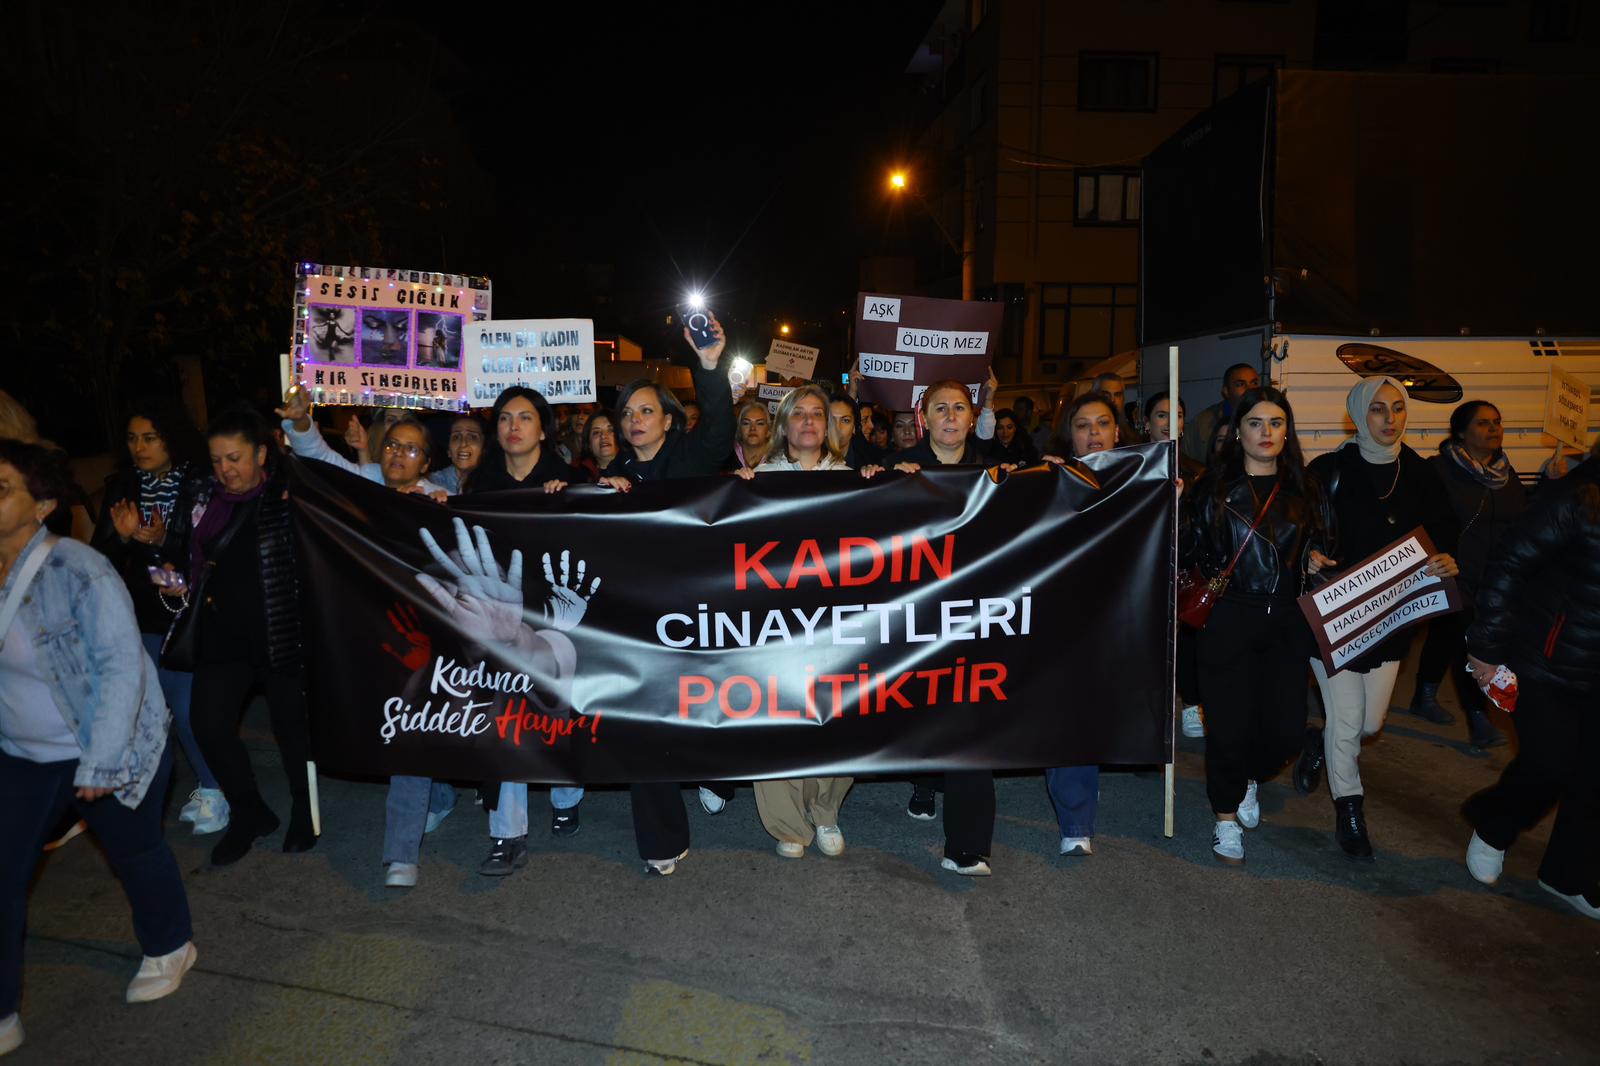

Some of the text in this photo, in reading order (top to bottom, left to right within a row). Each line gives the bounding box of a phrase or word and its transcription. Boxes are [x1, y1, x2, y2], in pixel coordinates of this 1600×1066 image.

[869, 303, 895, 317] AŞK
[480, 328, 512, 349] ÖLEN
[540, 330, 579, 347] KADIN
[902, 331, 983, 349] ÖLDÜR MEZ
[315, 369, 346, 386] KIR
[542, 352, 580, 372] İNSAN
[863, 356, 909, 374] ŞİDDET
[733, 533, 956, 591] KADIN
[1322, 543, 1417, 605] HAYATIMIZDAN
[655, 586, 1033, 648] CİNAYETLERİ
[430, 655, 534, 698] Kadına
[678, 656, 1009, 720] POLİTİKTİR
[380, 696, 604, 746] Şiddete Hayır!
